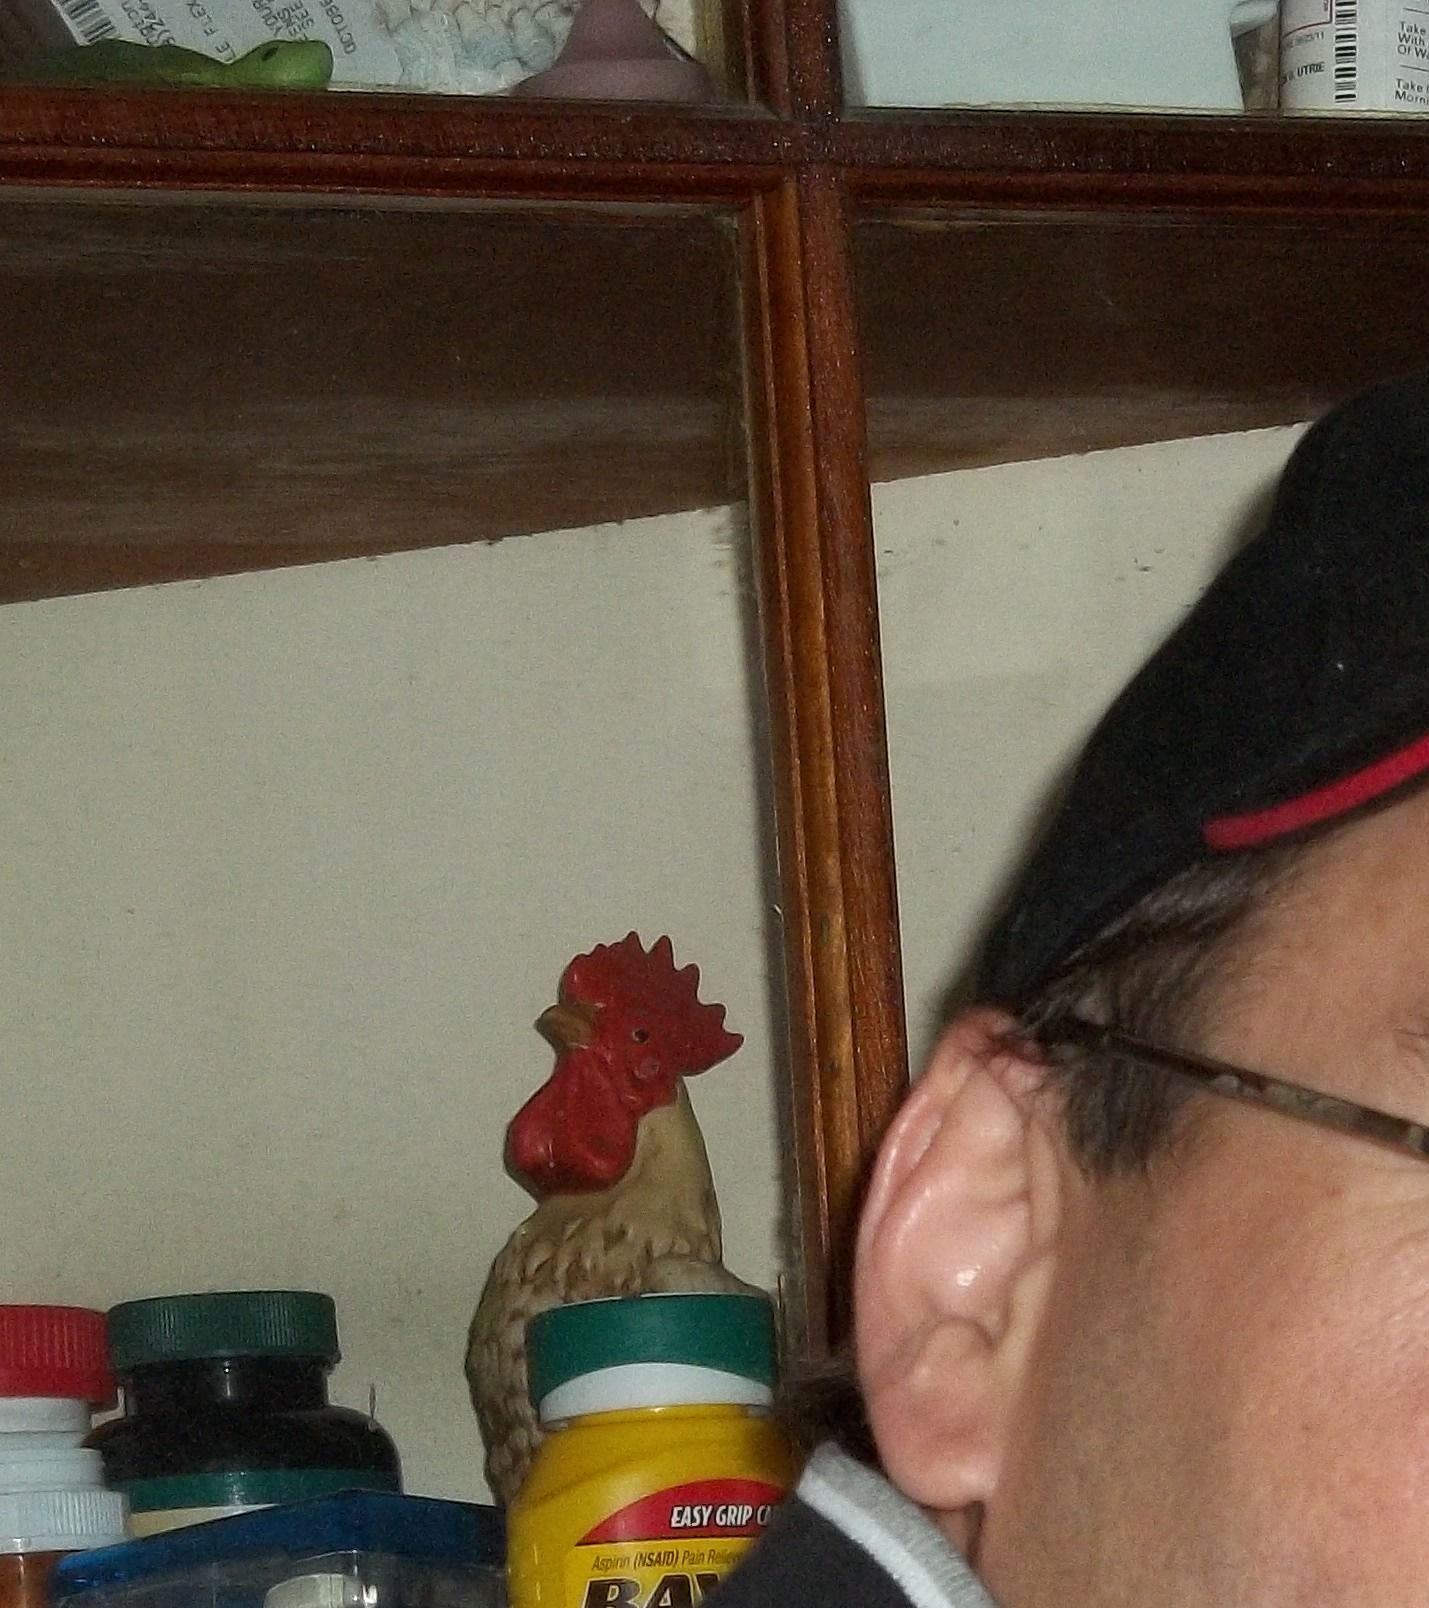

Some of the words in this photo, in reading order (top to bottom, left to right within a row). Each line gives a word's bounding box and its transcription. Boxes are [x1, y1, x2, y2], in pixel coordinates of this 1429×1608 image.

[1396, 78, 1423, 93] Take
[670, 1505, 712, 1527] EASY
[716, 1505, 752, 1526] GRIP
[592, 1553, 631, 1572] Aspirin
[633, 1549, 680, 1570] (NSAID)
[682, 1550, 704, 1566] Pain
